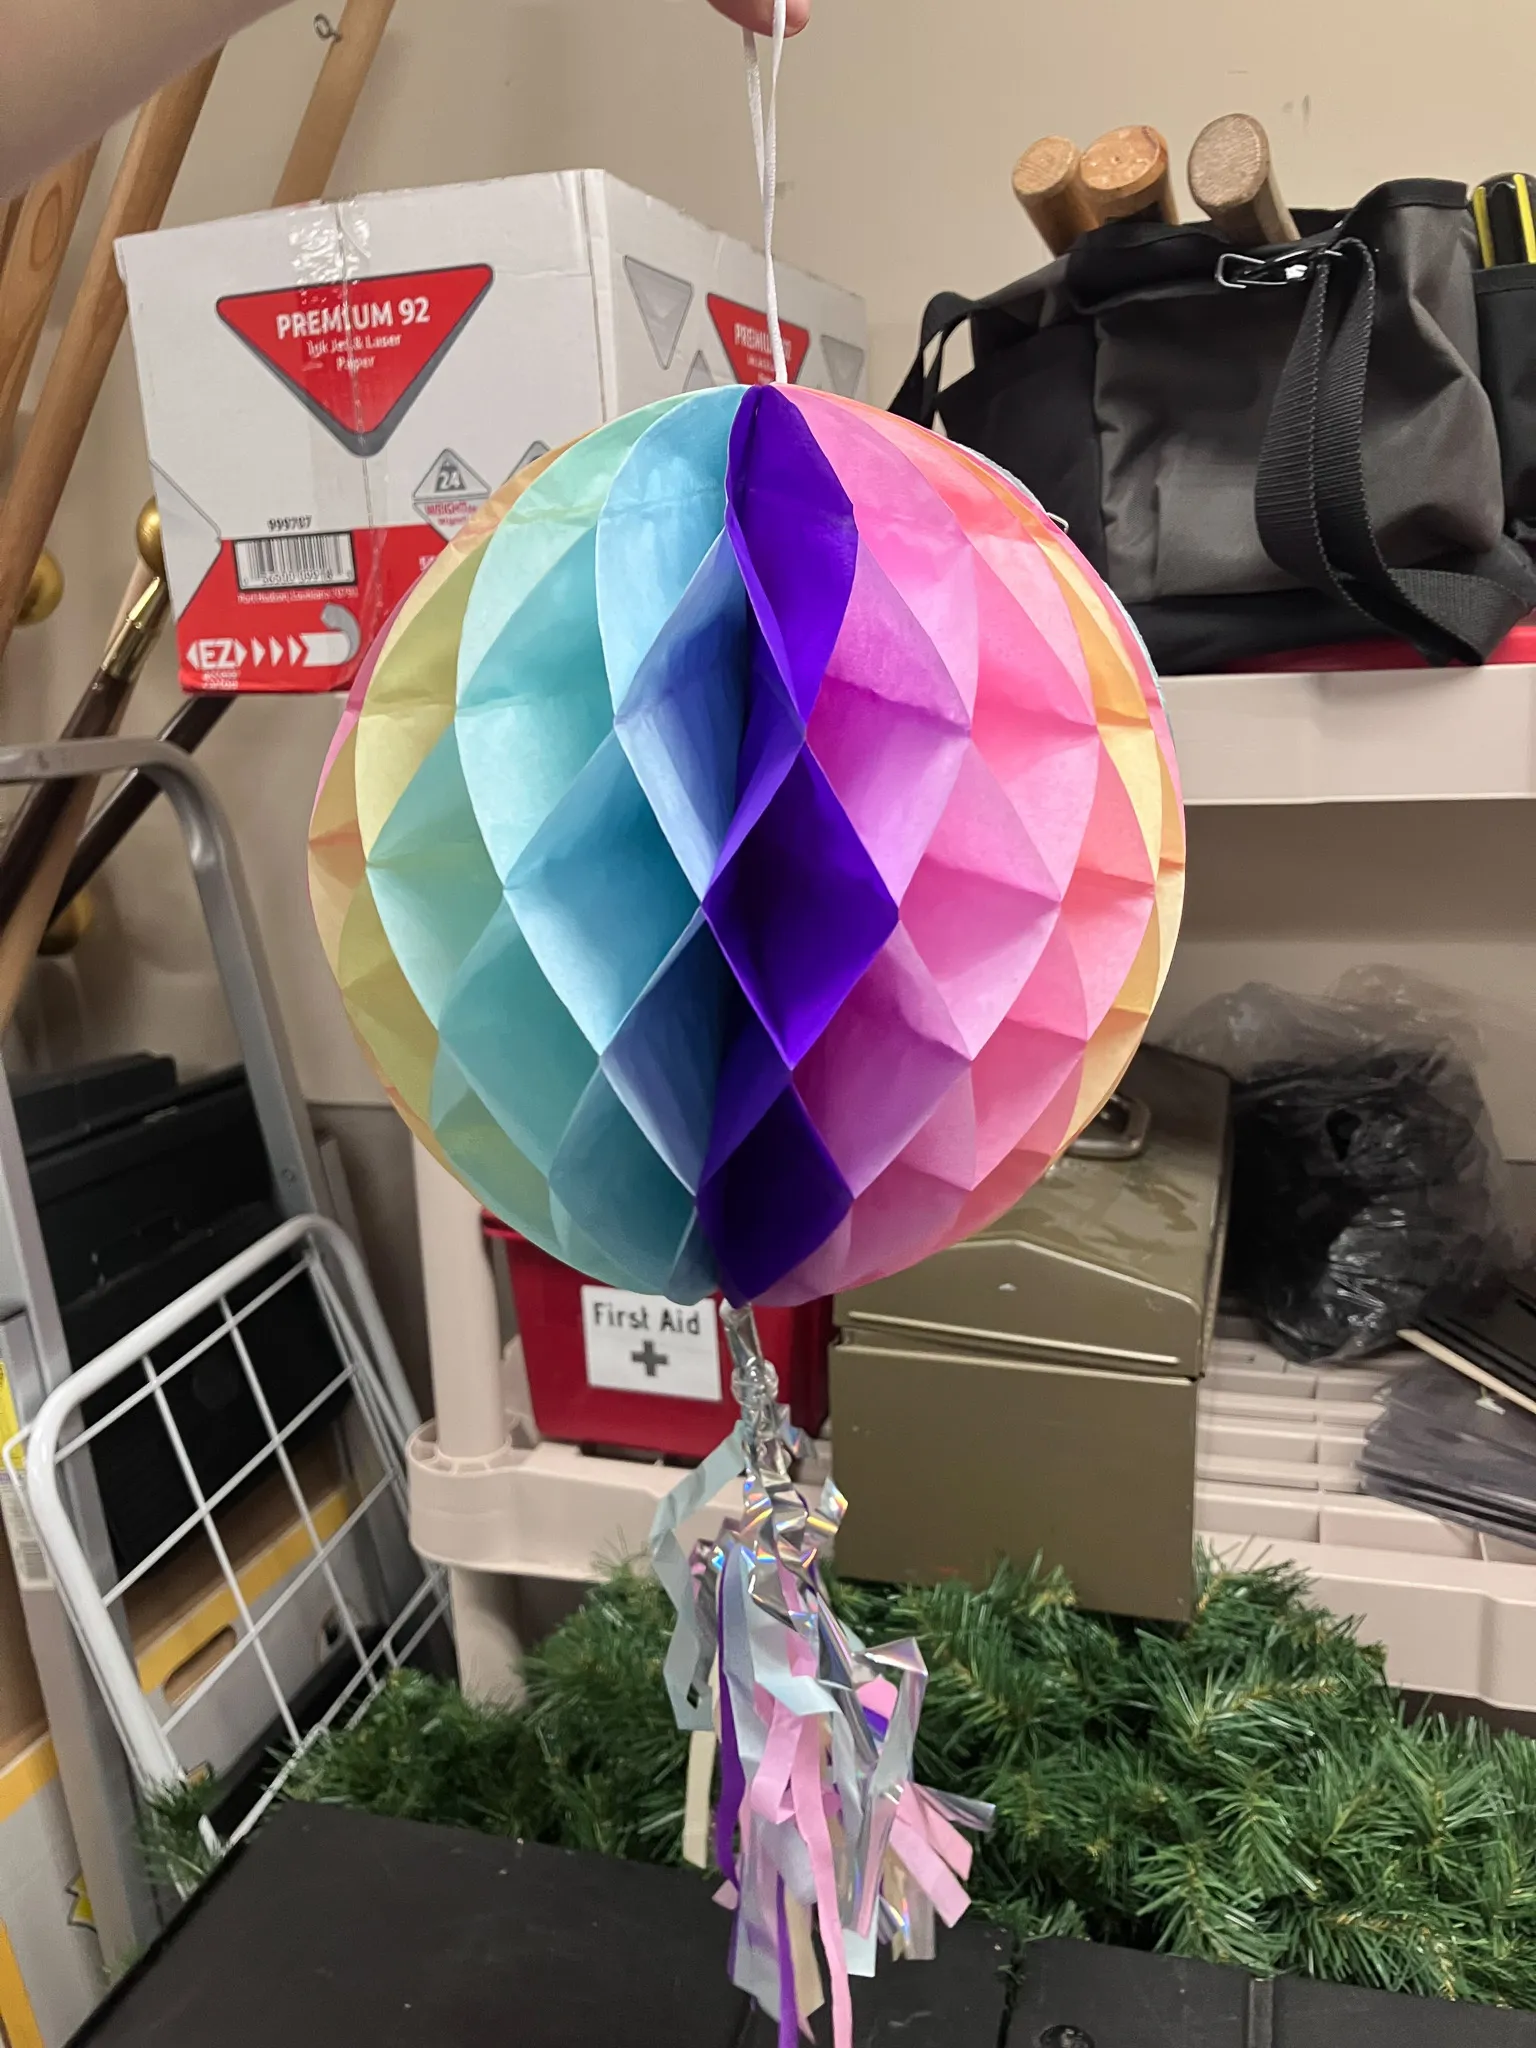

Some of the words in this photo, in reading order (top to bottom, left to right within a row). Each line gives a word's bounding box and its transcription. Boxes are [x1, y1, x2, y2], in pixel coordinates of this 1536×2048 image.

[276, 300, 393, 339] PREMIUM
[398, 296, 430, 326] 92
[365, 334, 402, 349] Laser
[336, 356, 375, 371] Paper
[440, 471, 460, 490] 24
[198, 637, 236, 670] EZ
[593, 1302, 650, 1331] First
[660, 1308, 701, 1336] Aid
